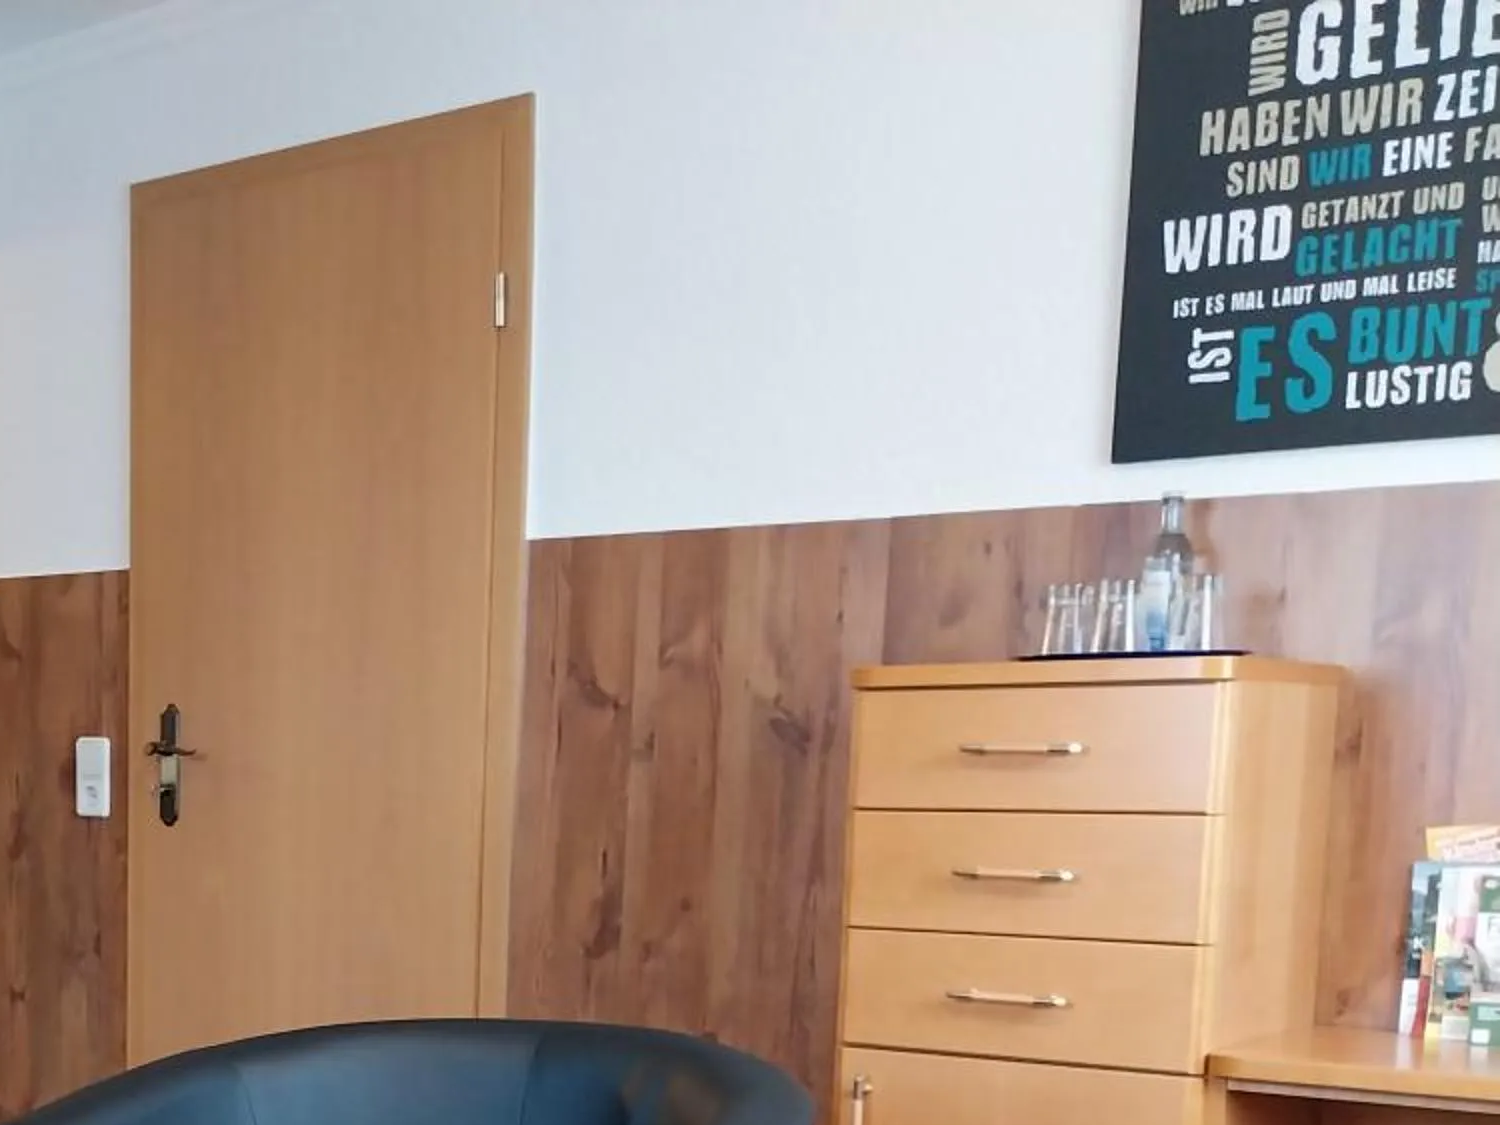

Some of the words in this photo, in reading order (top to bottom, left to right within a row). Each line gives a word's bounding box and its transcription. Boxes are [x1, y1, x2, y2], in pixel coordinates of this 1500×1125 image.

[1248, 9, 1290, 96] WIRD
[1295, 0, 1500, 85] GELIE
[1200, 93, 1331, 157] HABEN
[1340, 78, 1424, 136] WIR
[1226, 155, 1300, 198] SIND
[1309, 143, 1372, 188] WIR
[1382, 131, 1454, 177] EINE
[1163, 204, 1293, 275] WIRD
[1301, 190, 1405, 230] GETANZT
[1413, 182, 1466, 215] UND
[1295, 218, 1464, 277] GELACHT
[1173, 298, 1200, 319] IST
[1205, 294, 1225, 315] ES
[1231, 289, 1265, 312] MAL
[1272, 285, 1314, 307] LAUT
[1320, 278, 1357, 303] UND
[1362, 274, 1399, 297] MAL
[1407, 267, 1457, 291] LEISE
[1188, 327, 1235, 385] IST
[1348, 298, 1492, 365] BUNT
[1236, 311, 1336, 421] ES
[1345, 361, 1474, 410] LUSTIG
